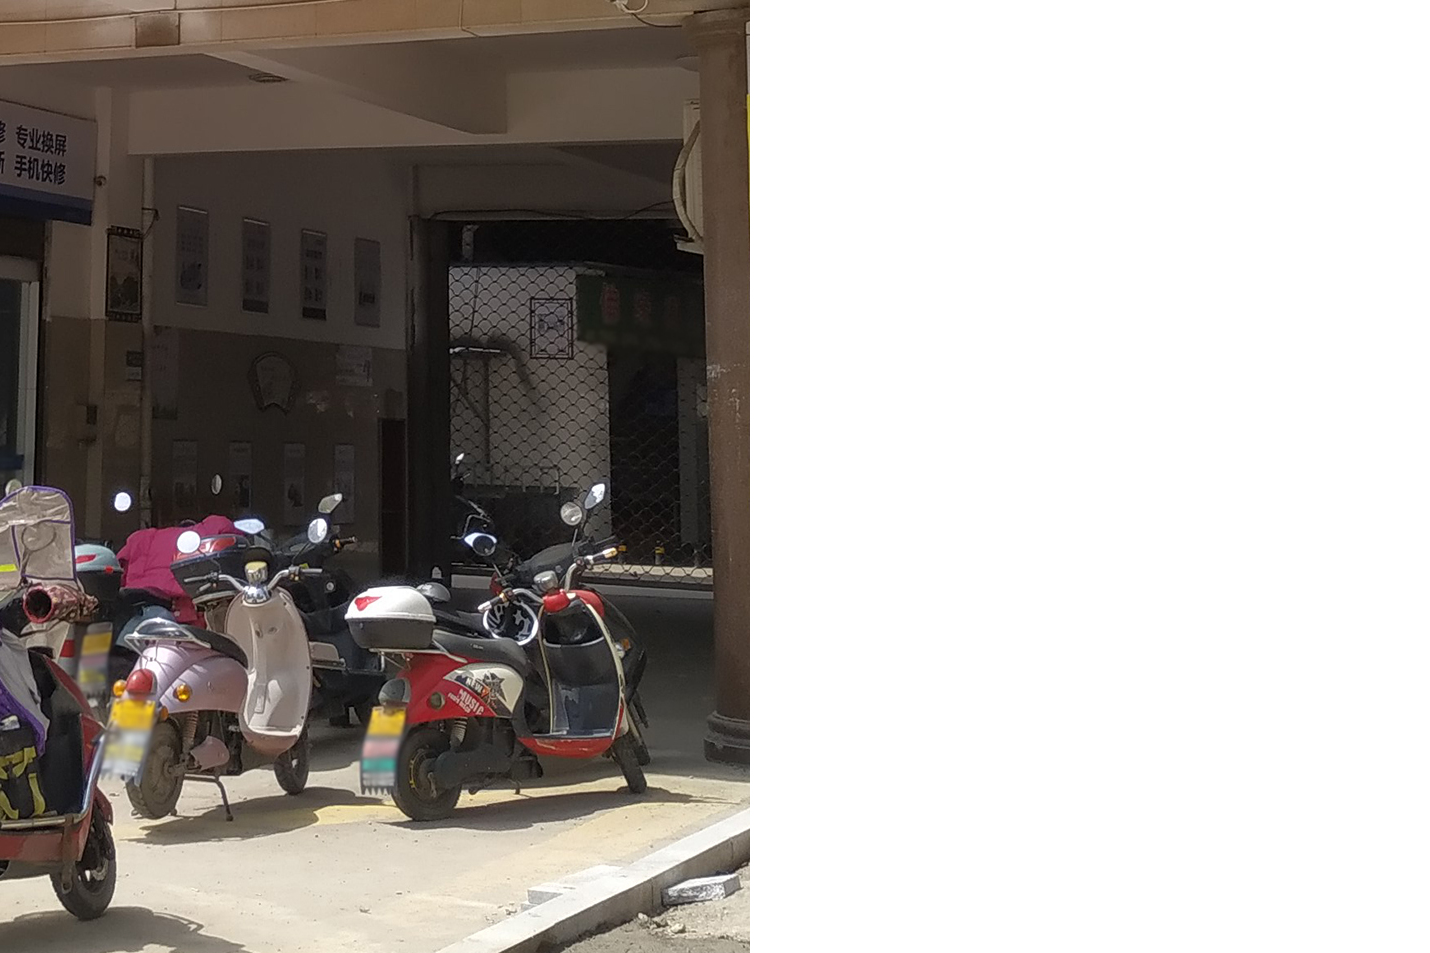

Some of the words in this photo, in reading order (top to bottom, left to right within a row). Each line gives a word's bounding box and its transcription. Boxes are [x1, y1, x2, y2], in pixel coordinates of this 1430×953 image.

[16, 125, 67, 157] 专业换屏
[14, 154, 66, 186] 手机快修
[458, 688, 485, 715] MUSIC
